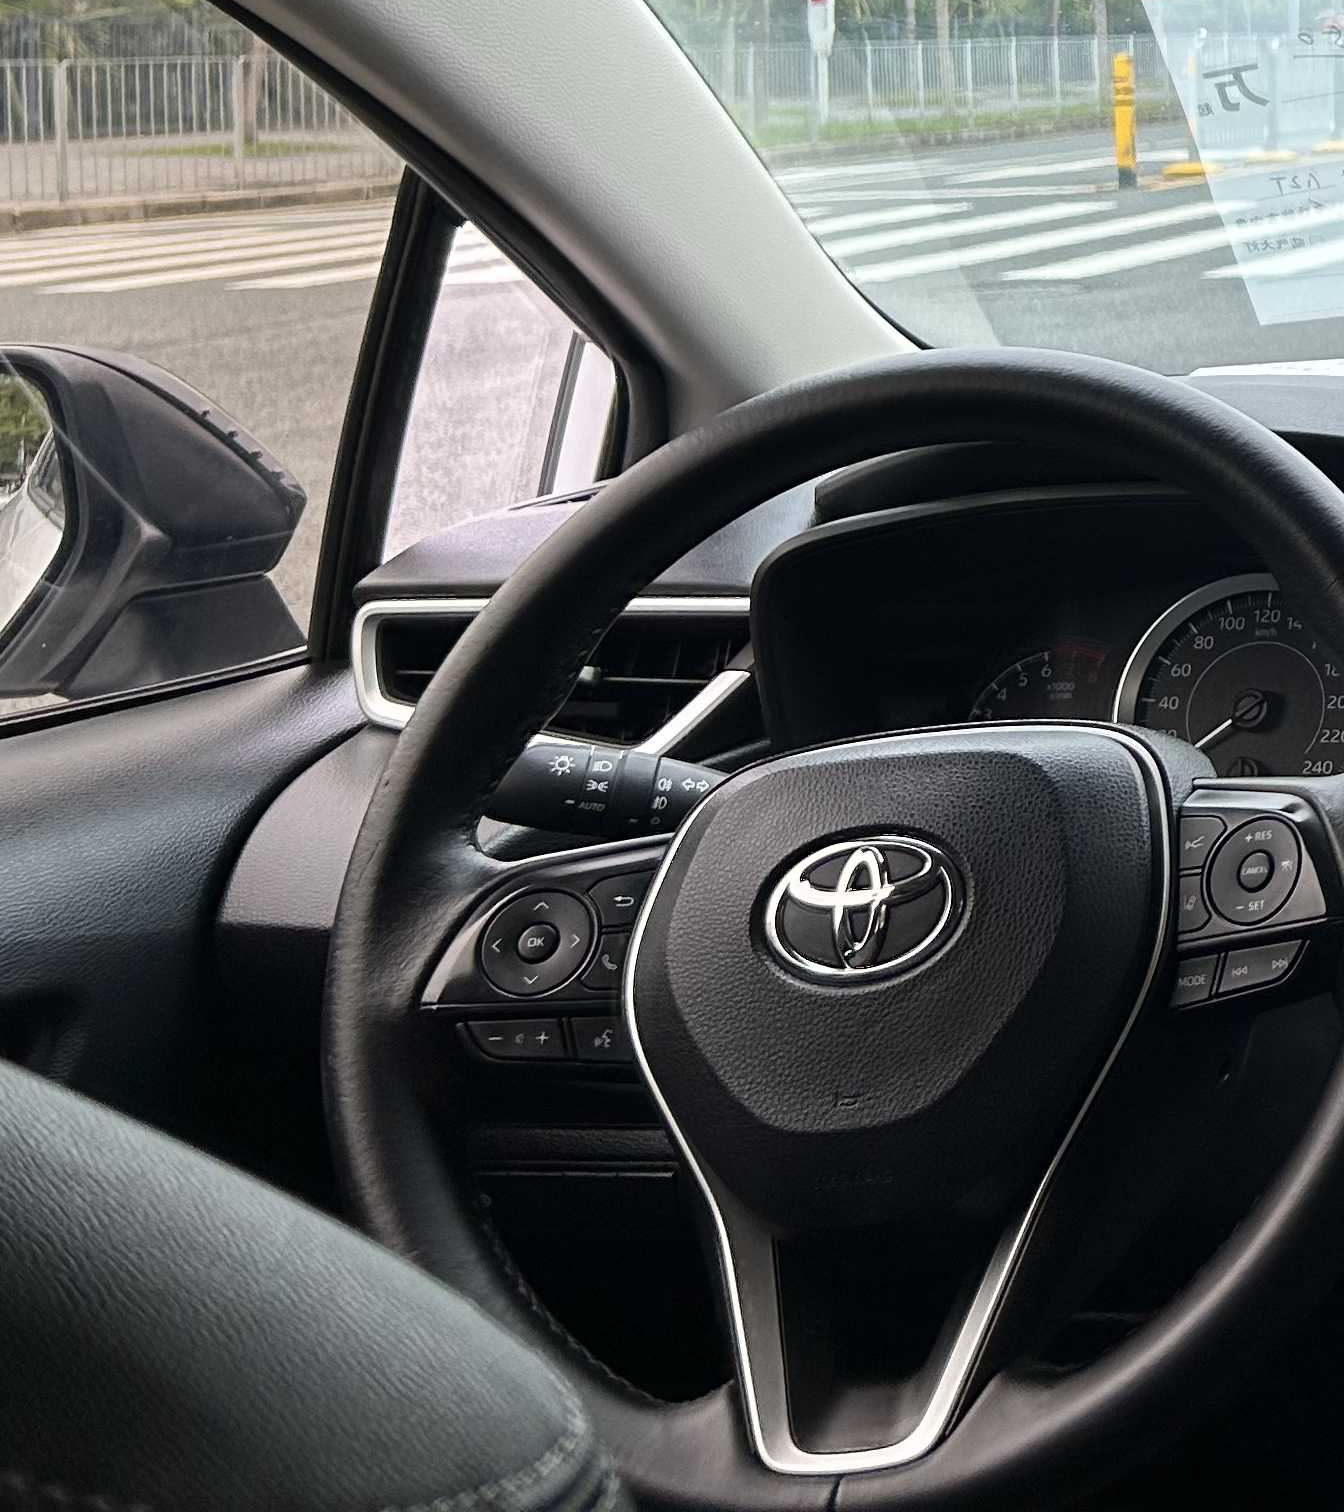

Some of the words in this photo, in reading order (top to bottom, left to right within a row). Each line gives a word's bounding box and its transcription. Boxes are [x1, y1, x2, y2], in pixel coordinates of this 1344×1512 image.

[1254, 610, 1280, 622] 120
[1218, 616, 1245, 630] 100
[1194, 636, 1214, 649] 80
[1041, 664, 1052, 677] 6
[1171, 662, 1191, 676] 60
[1018, 672, 1028, 687] 5
[1159, 696, 1179, 709] 40
[1303, 760, 1332, 774] 240
[579, 802, 605, 811] AUTO
[1257, 830, 1272, 840] RES
[1242, 866, 1267, 875] CANCEL
[1249, 900, 1264, 910] SET
[527, 937, 545, 948] OK
[1179, 976, 1207, 988] MODE
